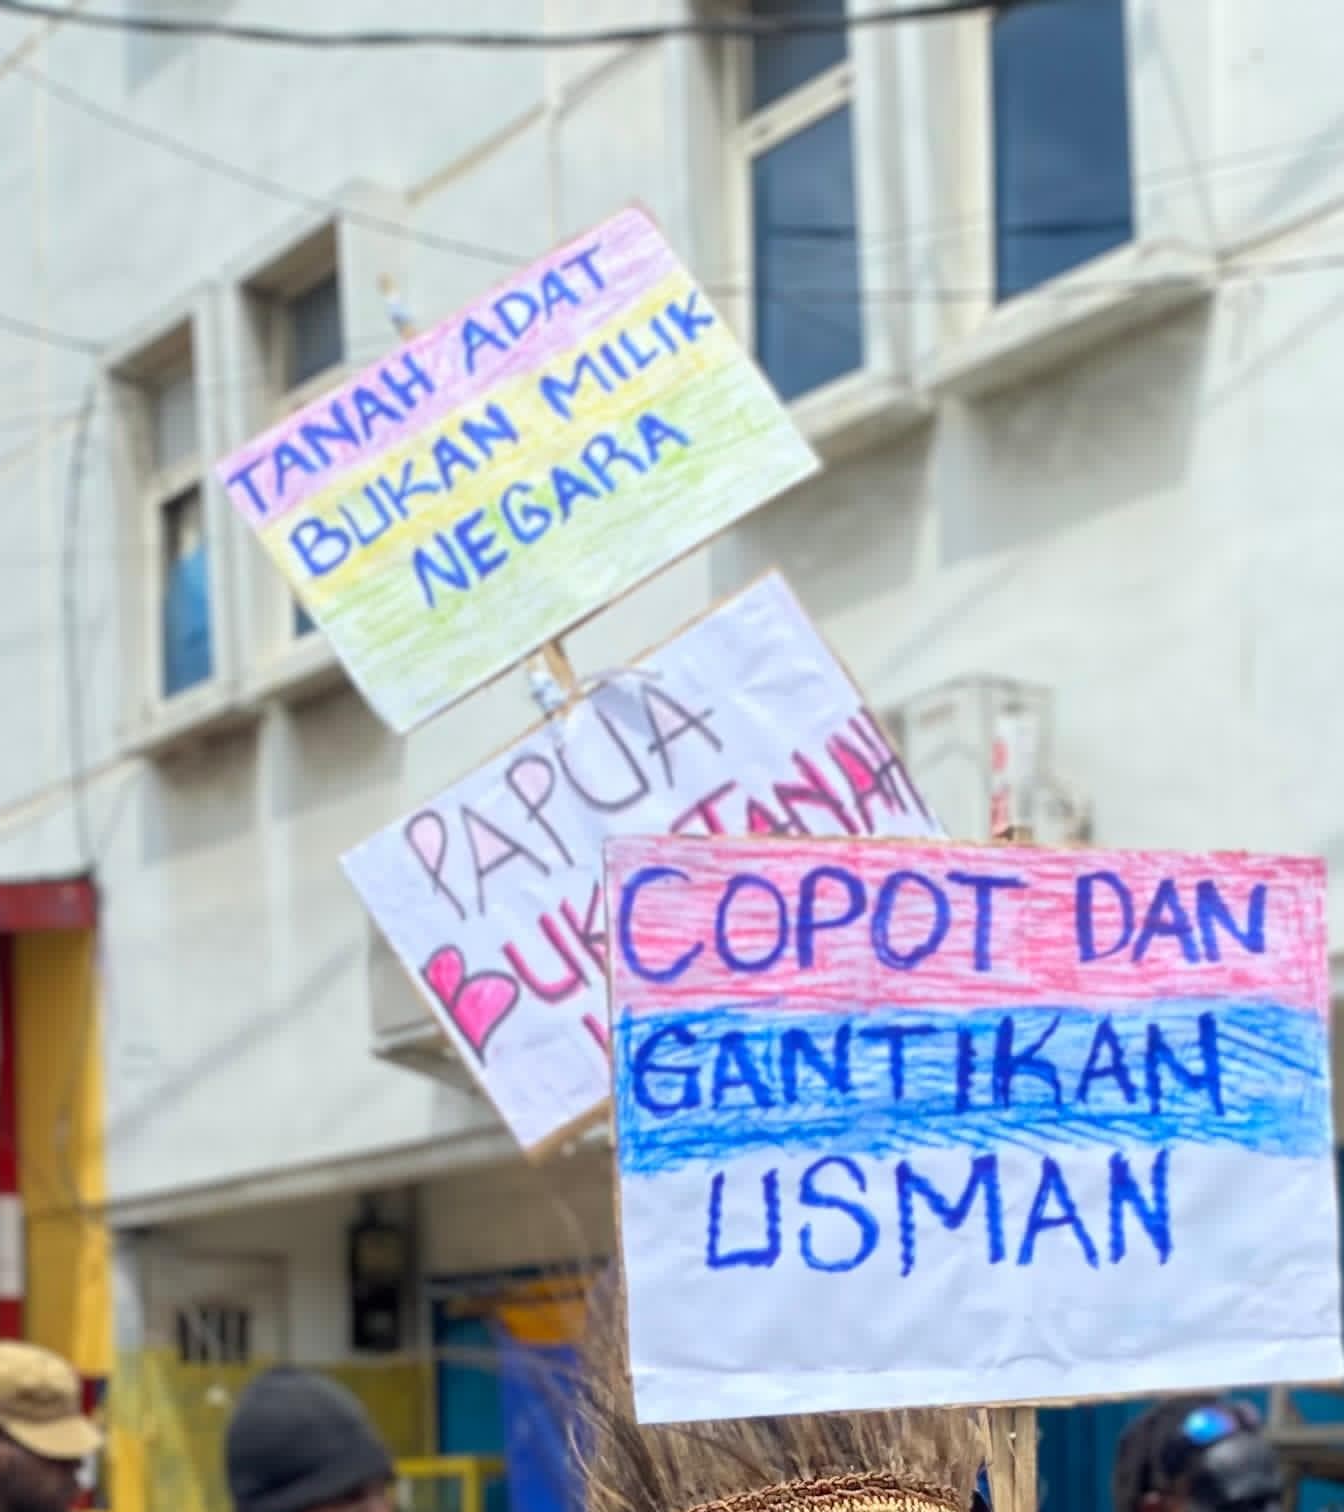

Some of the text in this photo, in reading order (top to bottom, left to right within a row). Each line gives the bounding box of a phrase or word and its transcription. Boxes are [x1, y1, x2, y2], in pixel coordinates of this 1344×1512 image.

[227, 243, 610, 516] TANAH ADAT
[287, 289, 716, 579] BUKAN MILIK
[409, 410, 692, 609] NEGARA
[403, 680, 724, 921] PAPUA
[617, 864, 1269, 984] COPOT DAN
[628, 1010, 1226, 1120] GANTIKAN
[704, 1147, 1175, 1279] USMAN
